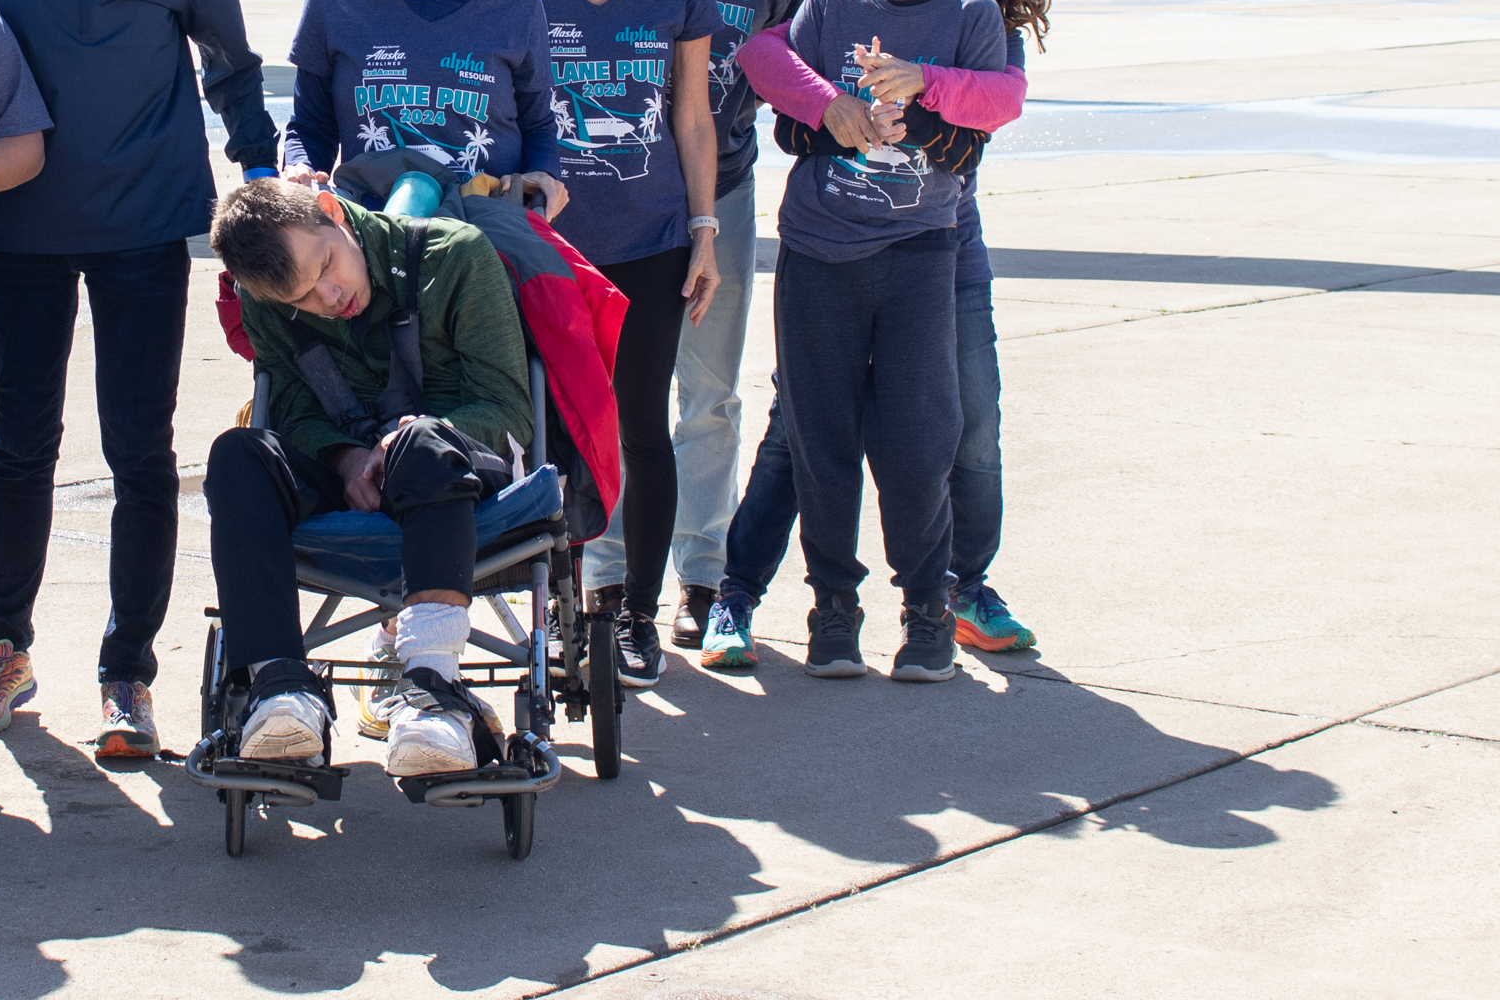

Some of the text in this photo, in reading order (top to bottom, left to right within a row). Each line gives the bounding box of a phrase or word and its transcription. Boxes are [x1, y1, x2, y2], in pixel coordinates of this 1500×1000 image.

[615, 25, 657, 45] alpha
[558, 46, 586, 54] Annual
[634, 41, 669, 50] RESOURCE
[440, 52, 485, 73] alpha
[362, 68, 407, 77] 3rd Annual
[459, 71, 496, 83] RESOURCE
[551, 59, 665, 88] LANE PULL
[458, 78, 481, 87] CENTER
[582, 82, 627, 98] 2024
[354, 84, 490, 123] PLANE PULL
[399, 109, 446, 126] 2024
[846, 192, 885, 203] ATLANTIC
